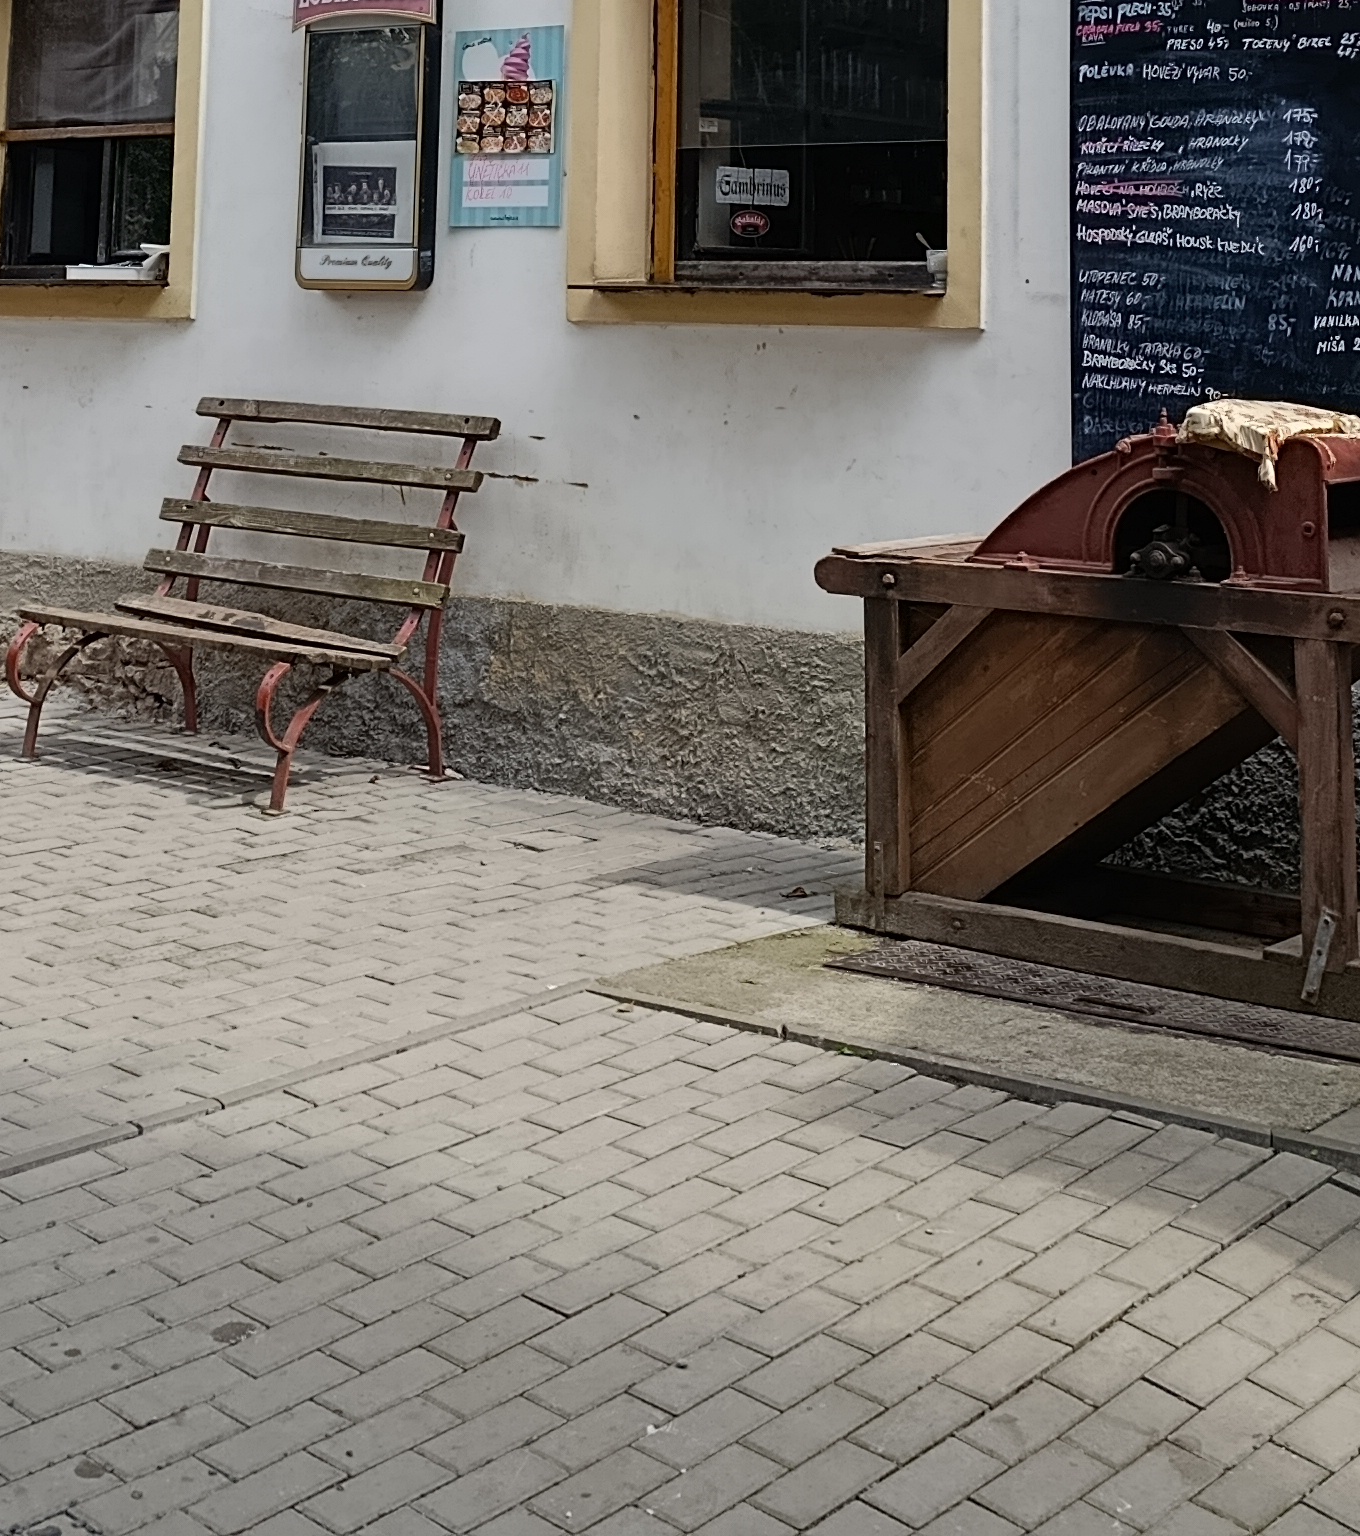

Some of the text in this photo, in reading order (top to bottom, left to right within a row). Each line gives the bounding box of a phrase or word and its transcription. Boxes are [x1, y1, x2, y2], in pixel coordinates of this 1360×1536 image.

[1077, 5, 1113, 25] PEPSI
[1116, 2, 1152, 24] PLECH
[1166, 38, 1204, 51] PRESO
[720, 173, 787, 199] Gambrinus
[320, 254, 393, 270] Premium Quality
[1080, 289, 1122, 309] MATESY
